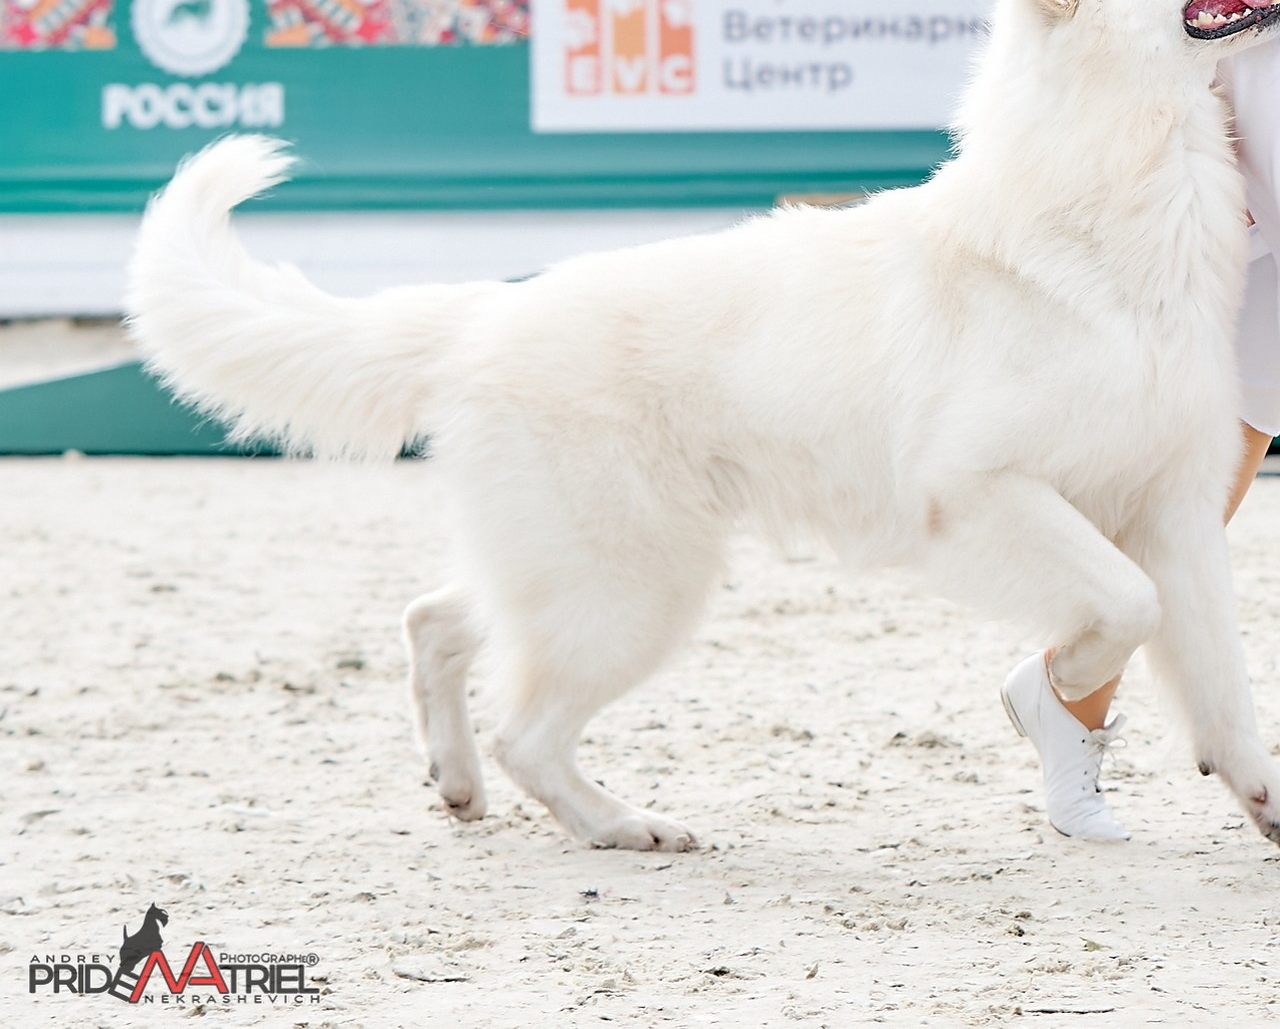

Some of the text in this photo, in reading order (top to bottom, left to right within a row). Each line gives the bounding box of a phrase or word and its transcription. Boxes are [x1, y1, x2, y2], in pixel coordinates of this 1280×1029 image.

[572, 57, 690, 89] EVC
[723, 57, 853, 93] Центр
[102, 82, 284, 129] РОССИЯ
